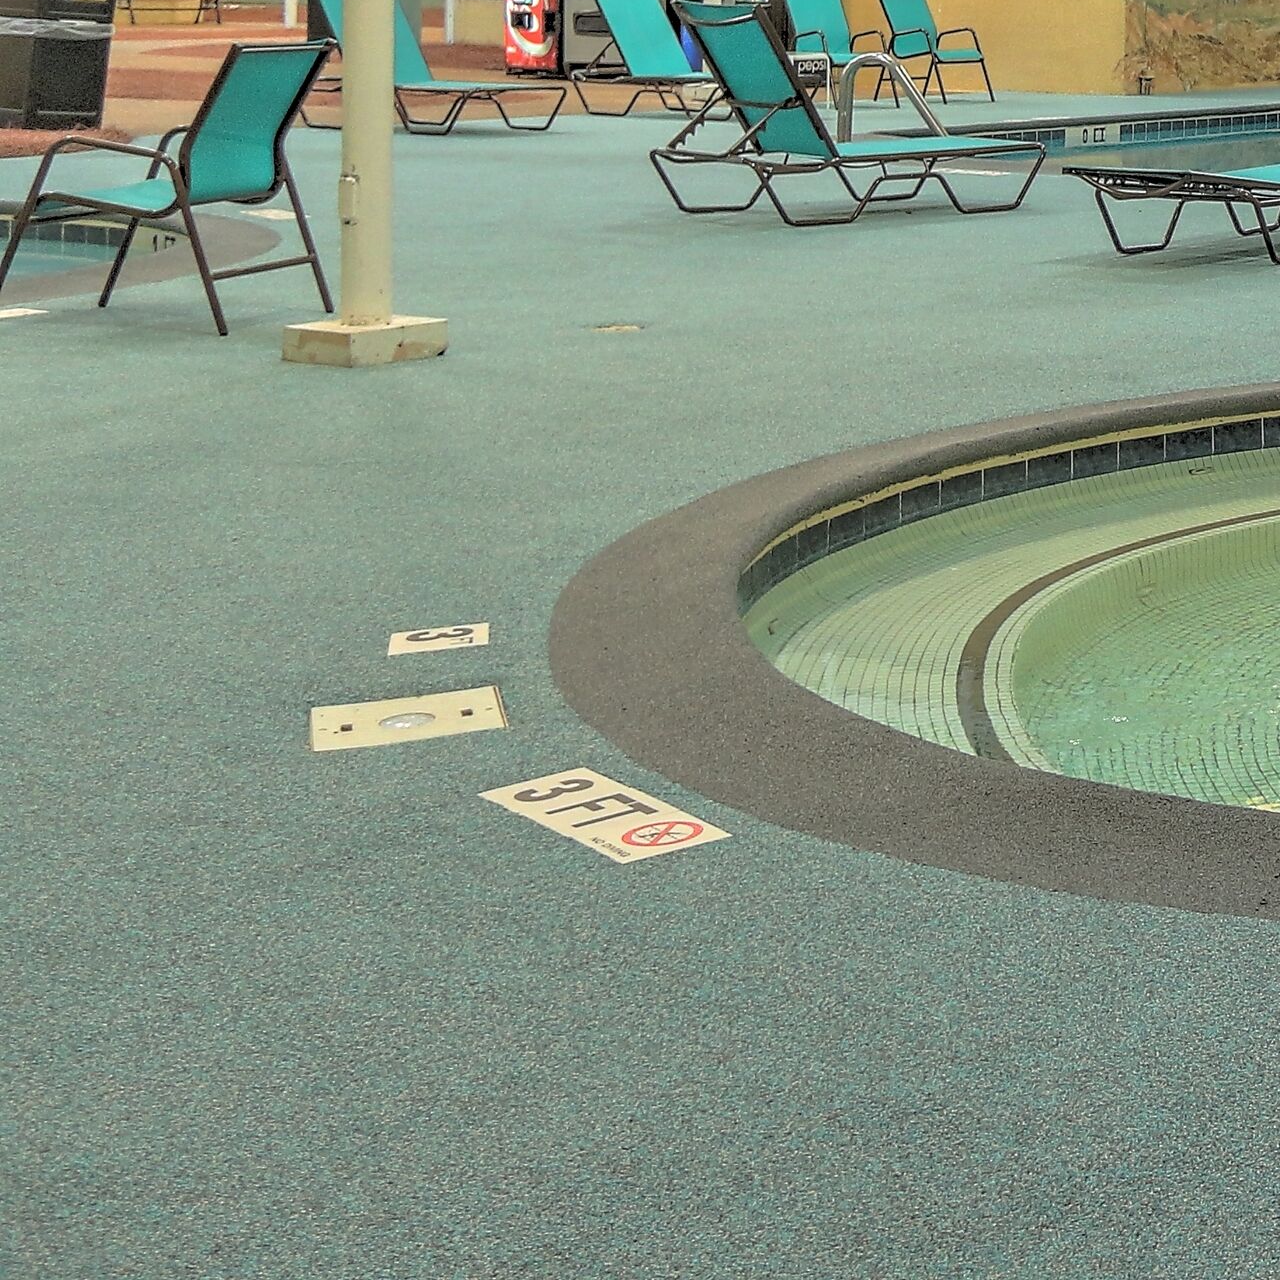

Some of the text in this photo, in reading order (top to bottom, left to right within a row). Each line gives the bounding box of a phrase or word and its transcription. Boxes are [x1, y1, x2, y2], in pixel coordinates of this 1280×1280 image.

[405, 627, 474, 642] 3
[512, 777, 659, 829] 3 FT
